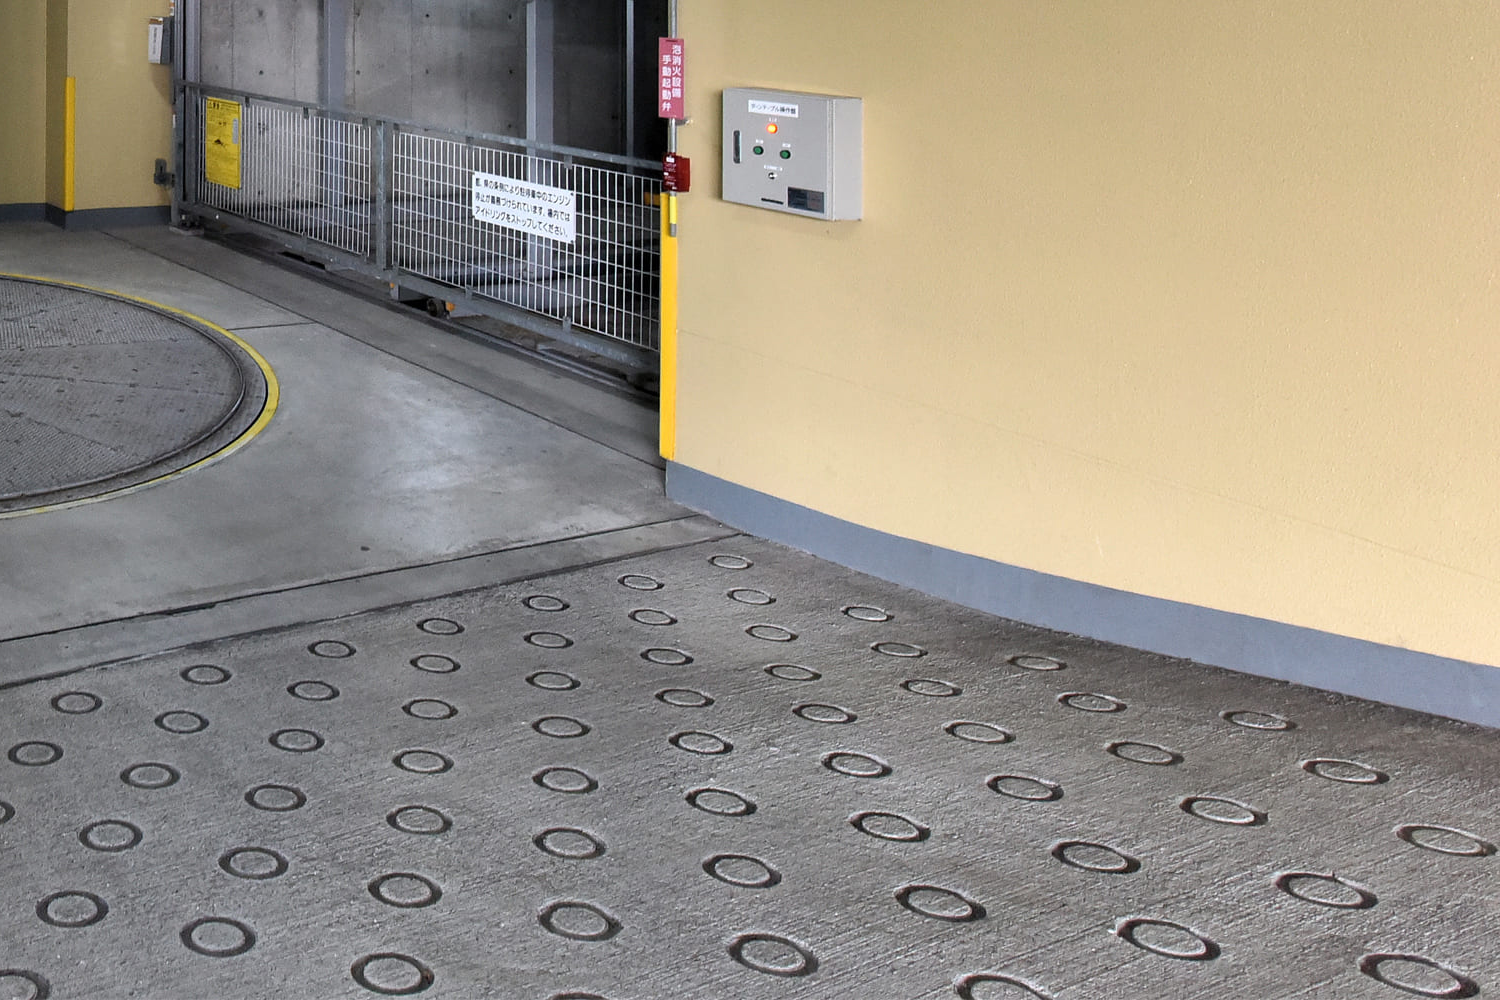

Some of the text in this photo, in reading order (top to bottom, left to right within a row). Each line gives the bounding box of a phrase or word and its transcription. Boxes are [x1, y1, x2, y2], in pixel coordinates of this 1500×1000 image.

[662, 54, 672, 112] 手動起動弁
[672, 44, 682, 98] 泡消火設備
